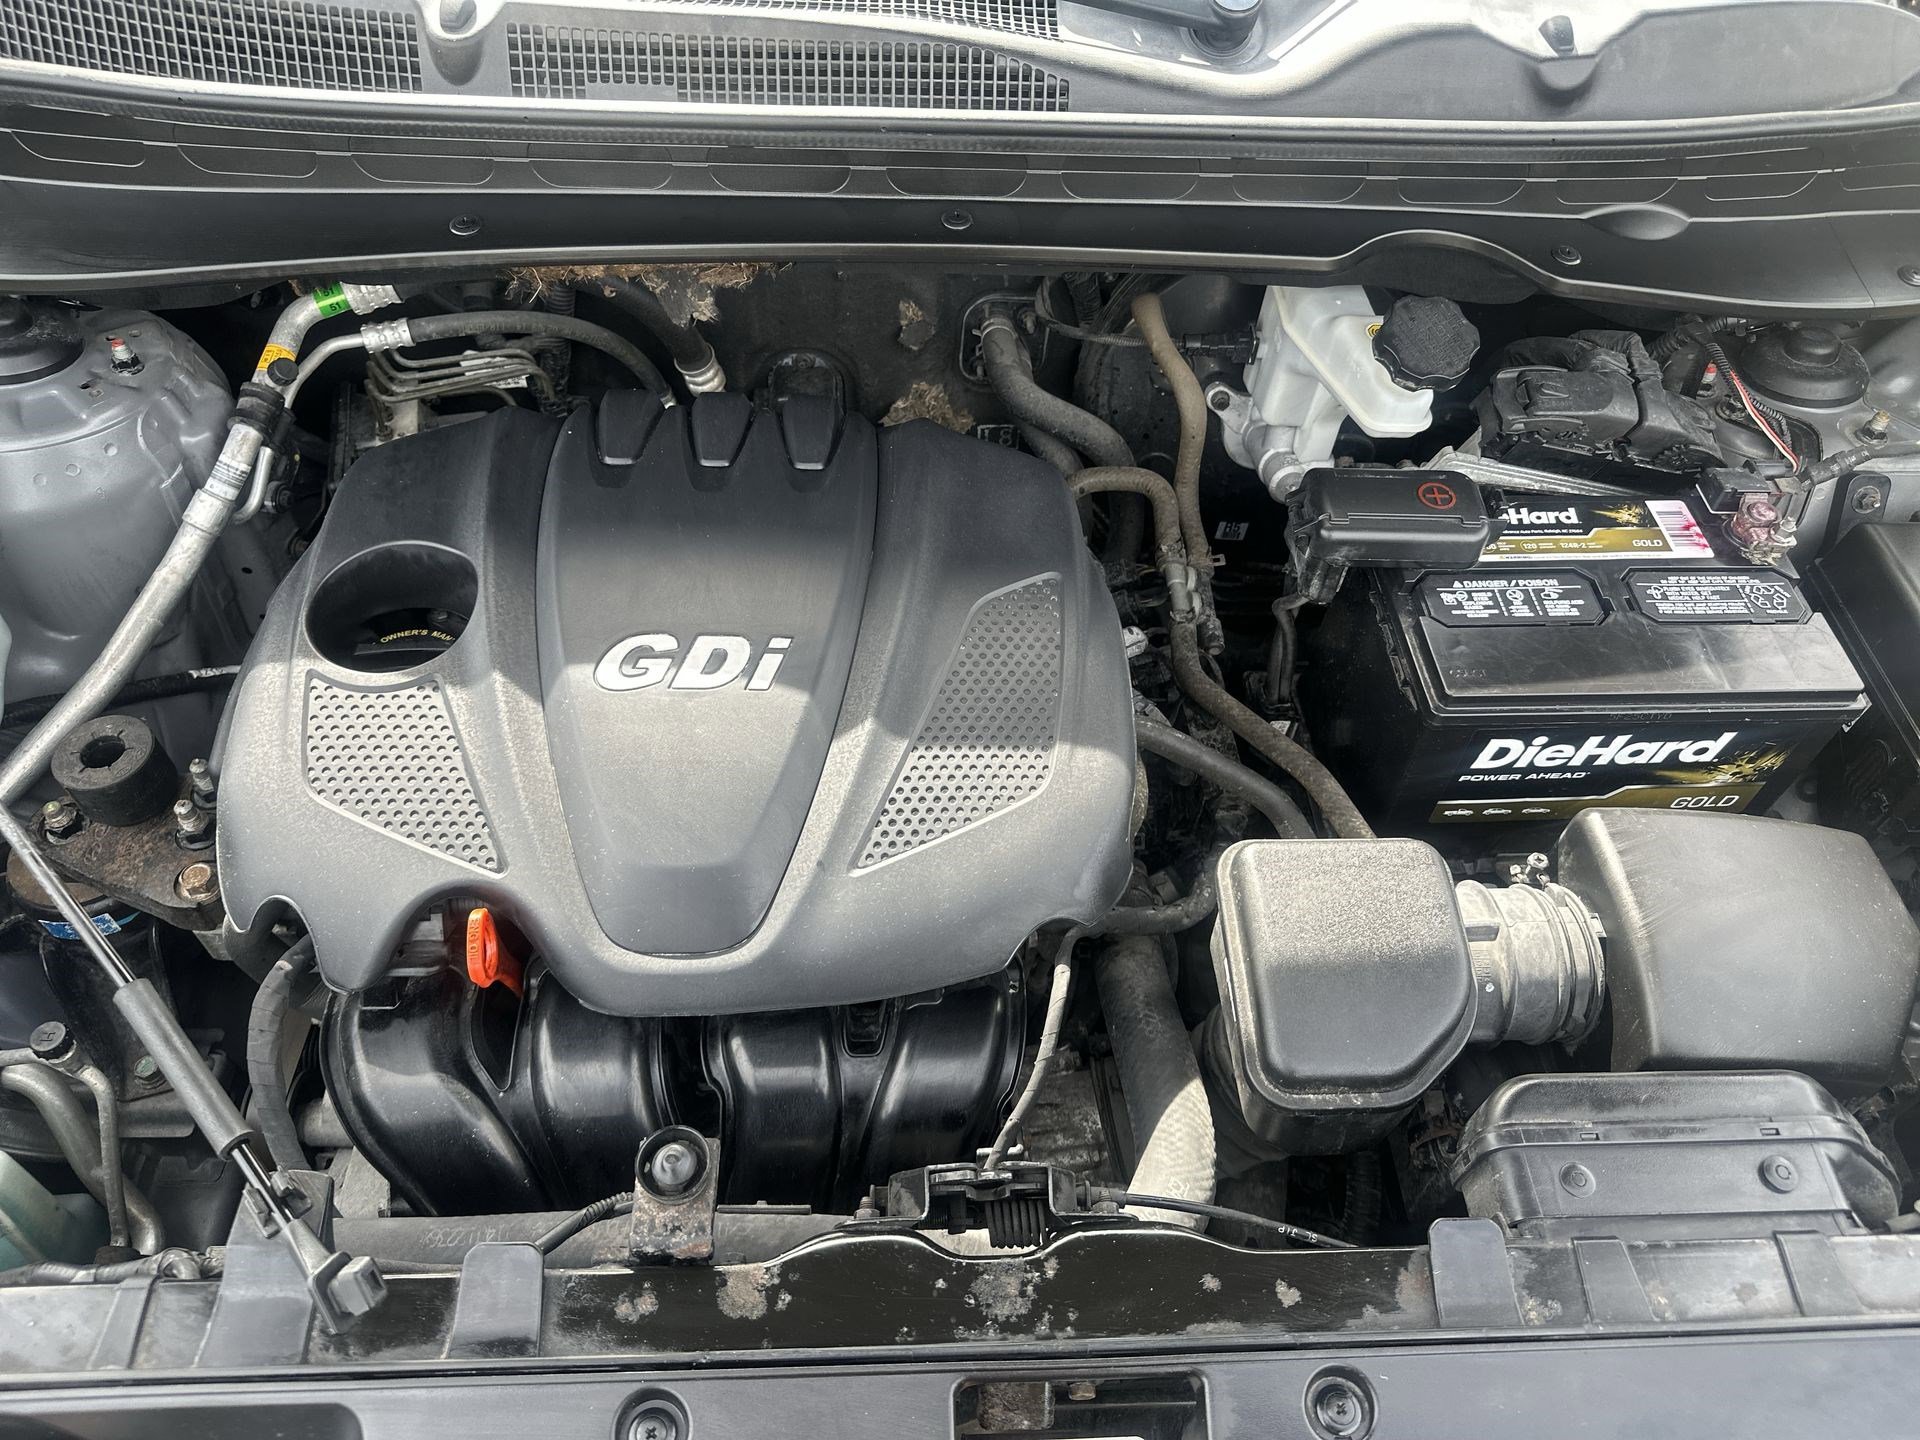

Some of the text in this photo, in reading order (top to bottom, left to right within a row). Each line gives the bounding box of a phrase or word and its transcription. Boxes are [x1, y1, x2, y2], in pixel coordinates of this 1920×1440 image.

[329, 302, 342, 312] 51
[1499, 507, 1580, 525] Hard
[1632, 539, 1663, 547] GOLD
[1463, 579, 1508, 588] DANGER
[1518, 578, 1560, 587] POISON
[380, 629, 456, 643] OWNER'S MAN
[593, 632, 794, 692] GDi
[1469, 732, 1739, 769] DieHard
[1458, 771, 1588, 782] POWER AHEAD
[1670, 795, 1740, 808] GOLD
